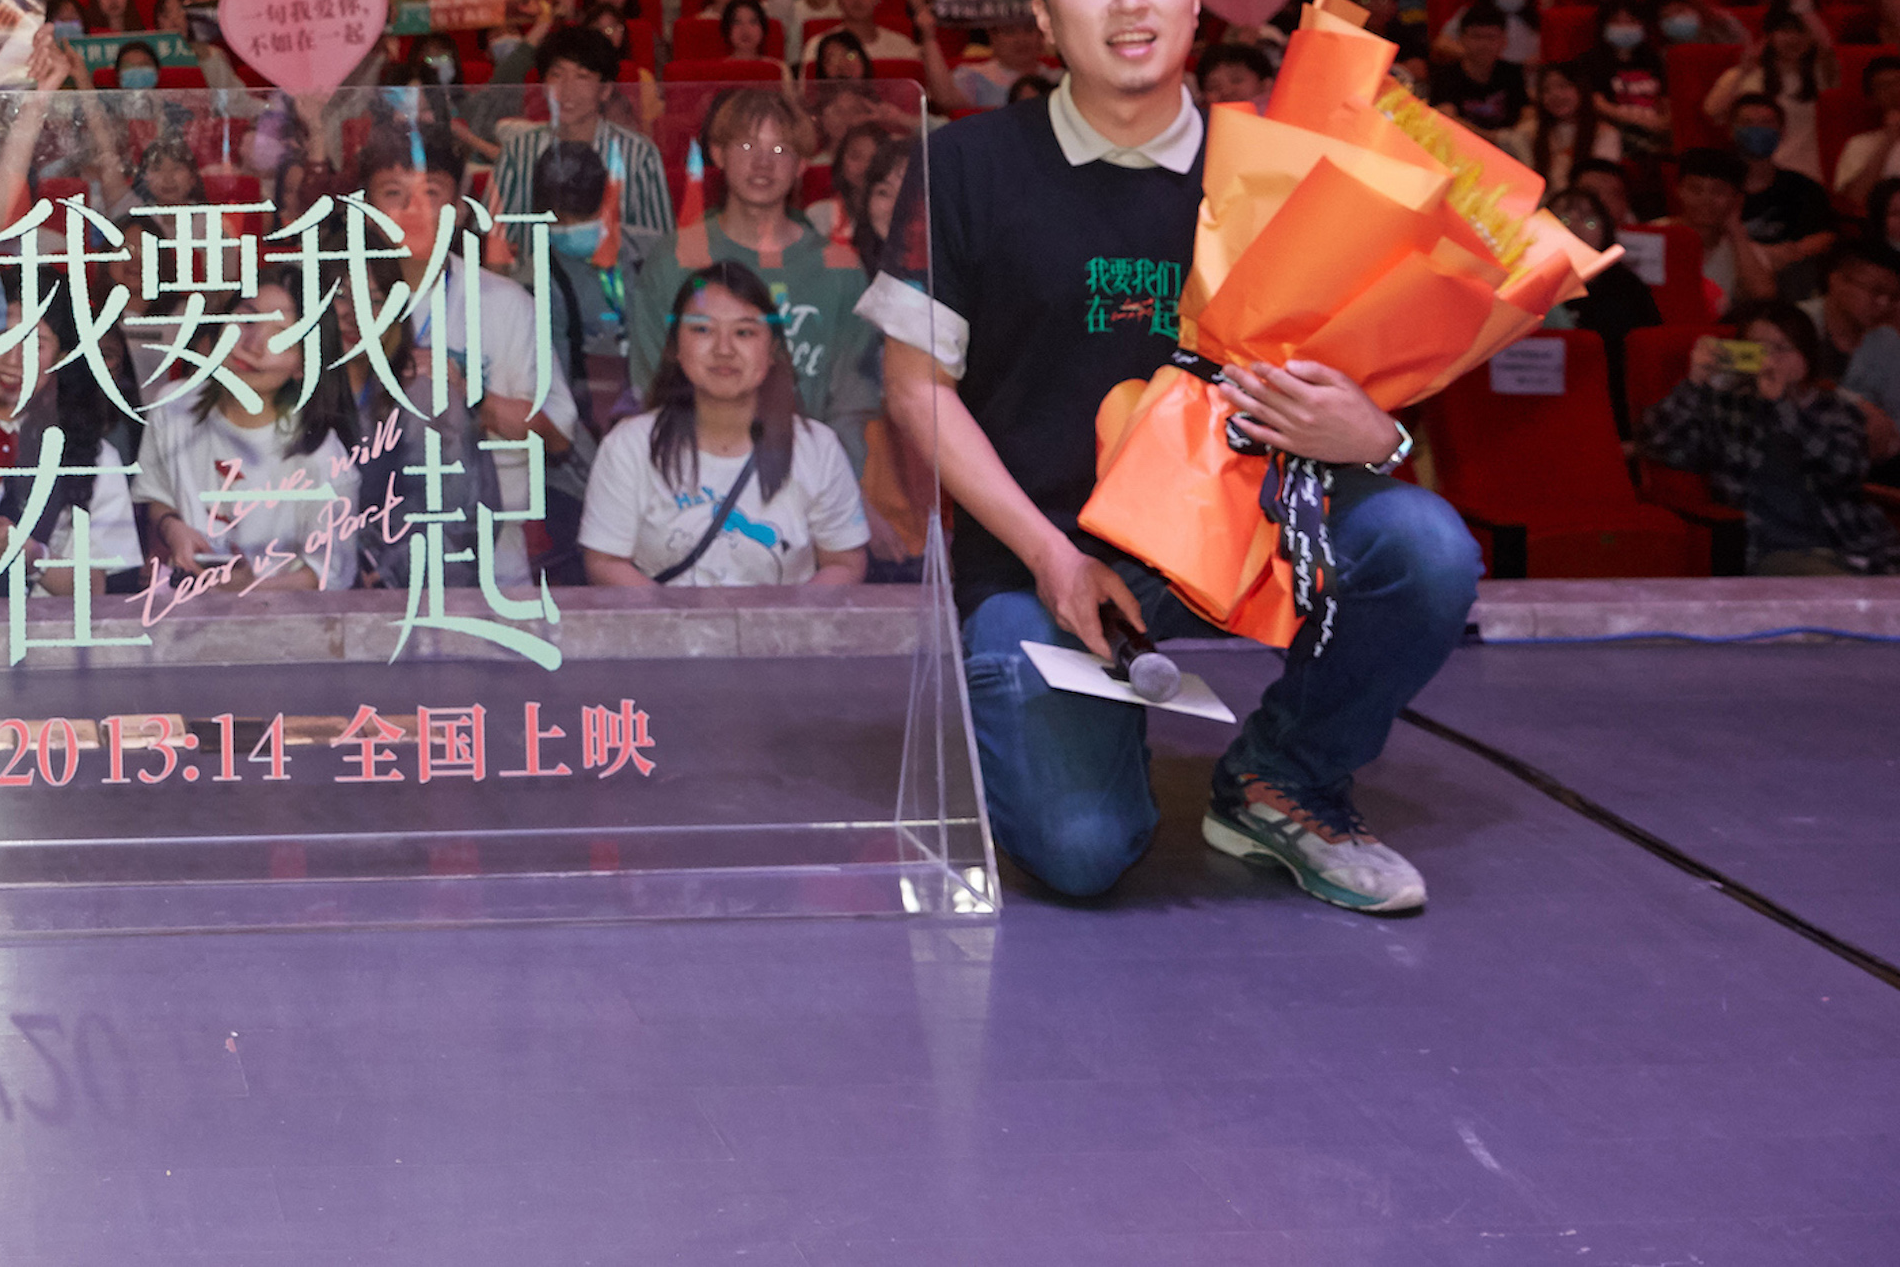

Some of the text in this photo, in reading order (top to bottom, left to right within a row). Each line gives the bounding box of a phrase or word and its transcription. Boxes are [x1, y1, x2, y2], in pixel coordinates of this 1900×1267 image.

[1084, 256, 1181, 298] 我要我们
[1084, 295, 1179, 341] 在一起
[330, 407, 403, 479] will
[124, 470, 413, 627] tear us apart
[100, 711, 293, 786] 13:14
[333, 698, 658, 785] 全国上映
